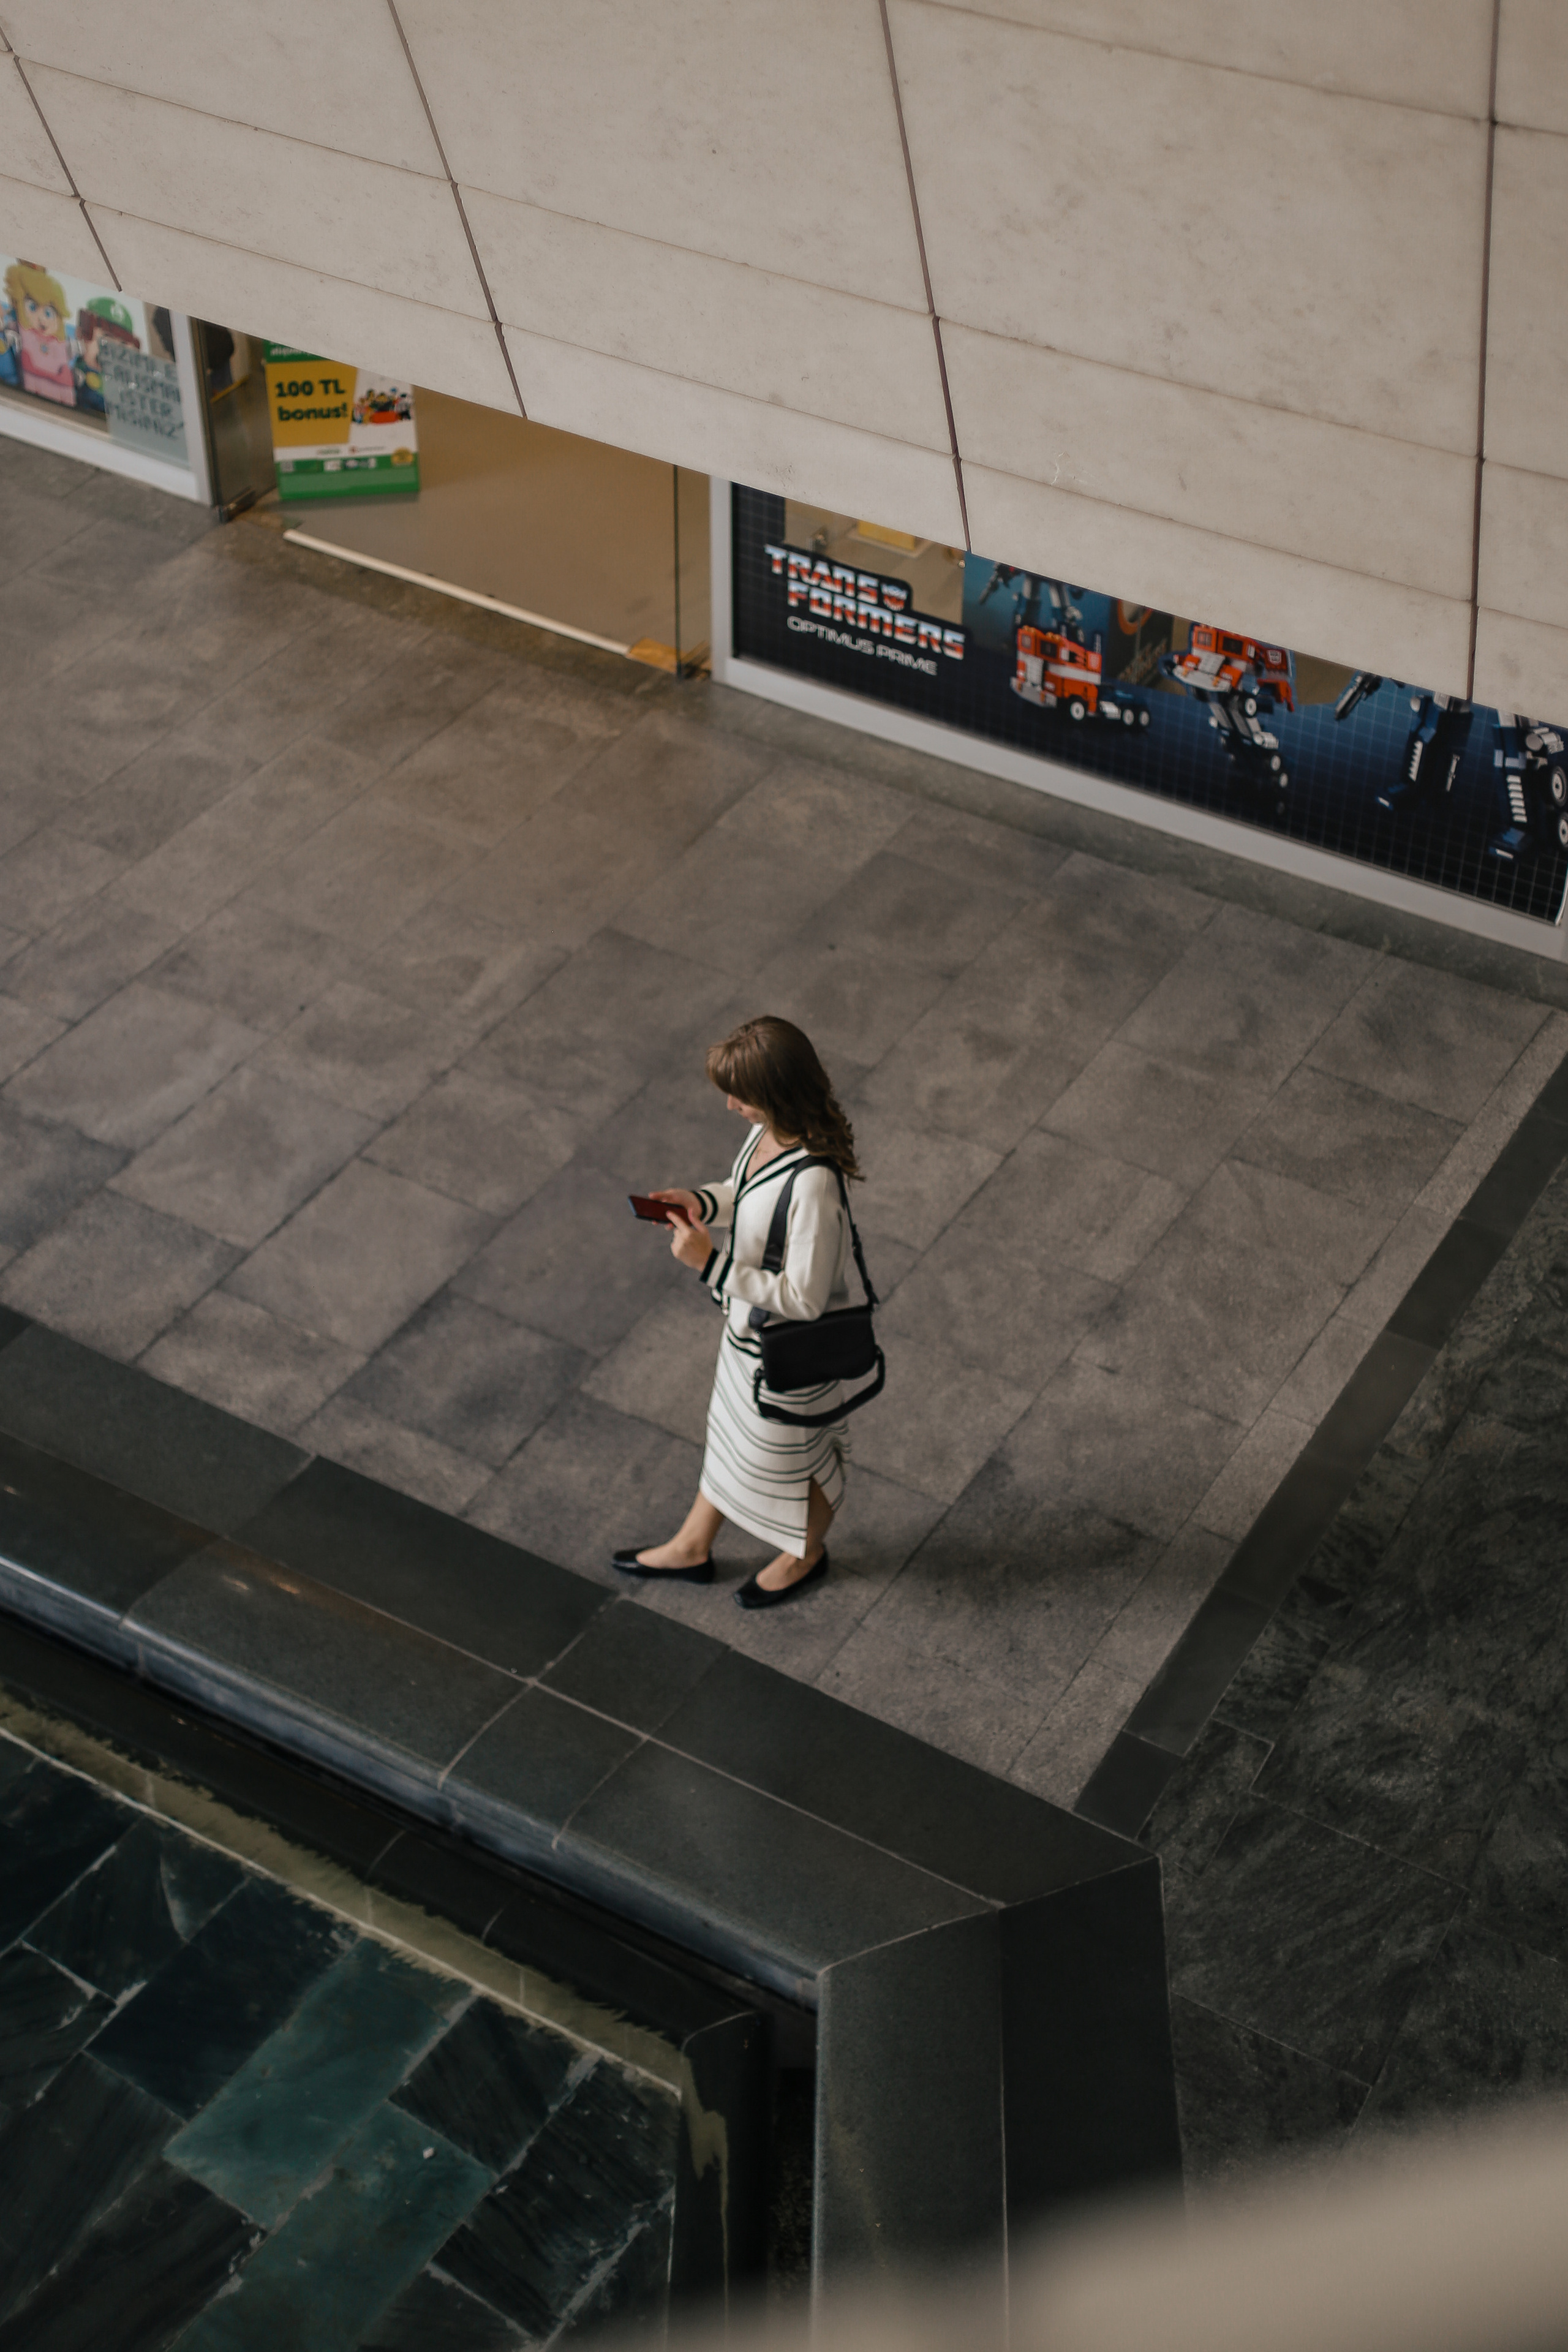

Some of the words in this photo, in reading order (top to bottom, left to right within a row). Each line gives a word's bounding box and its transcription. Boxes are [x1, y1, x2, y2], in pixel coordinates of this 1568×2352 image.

[276, 380, 314, 397] 100
[318, 379, 346, 395] TL
[277, 402, 348, 421] bonus!
[764, 543, 879, 604] TRANS
[787, 579, 965, 660] FORMERS
[787, 615, 875, 655] OPTIMUS
[876, 644, 938, 676] PRIME
